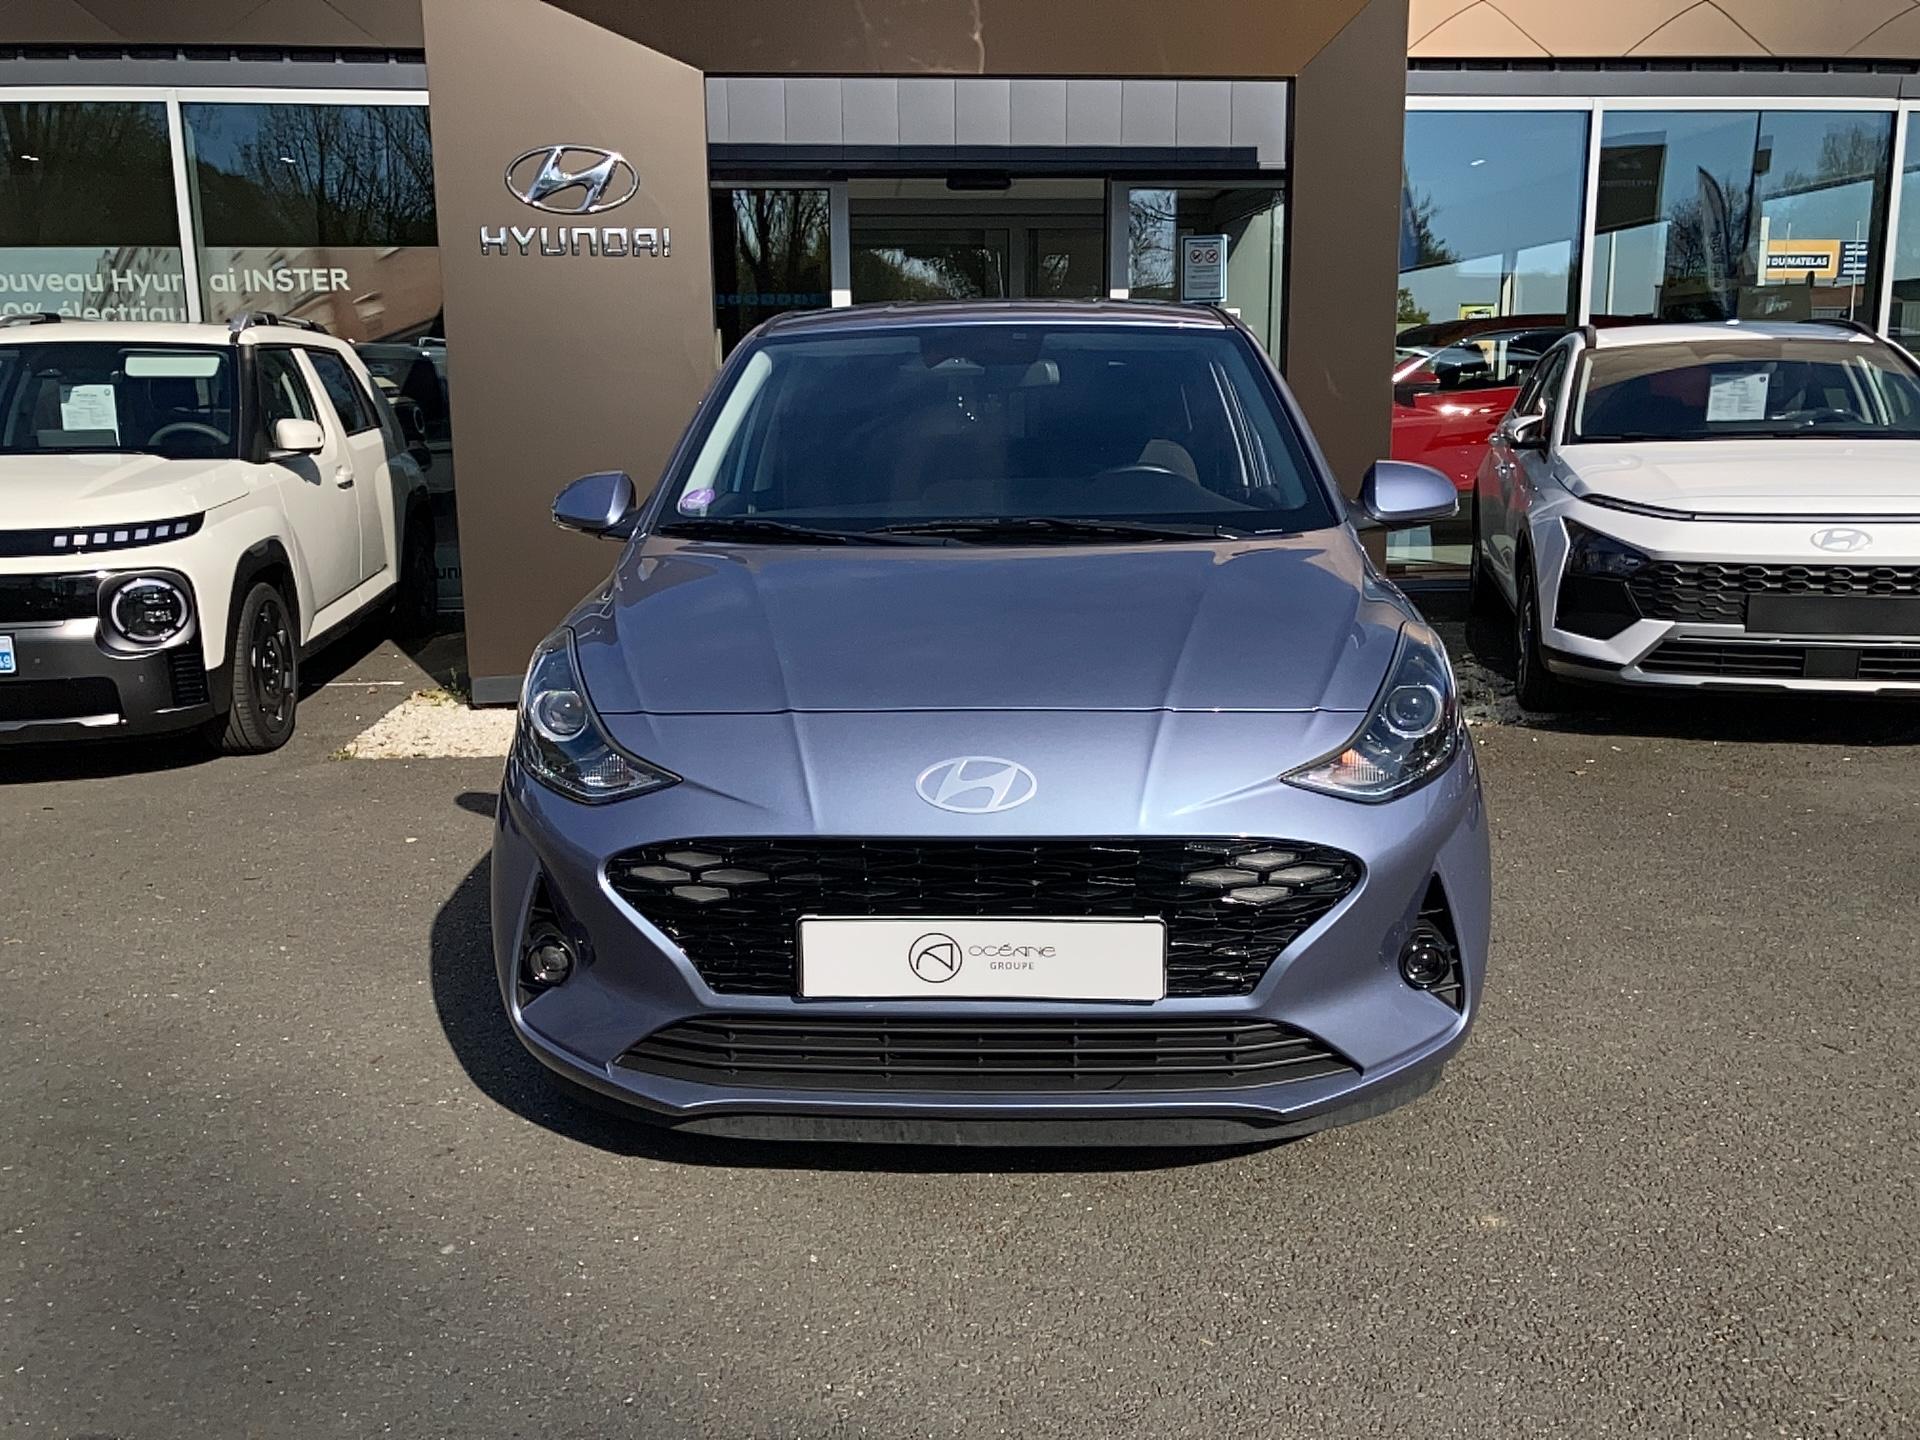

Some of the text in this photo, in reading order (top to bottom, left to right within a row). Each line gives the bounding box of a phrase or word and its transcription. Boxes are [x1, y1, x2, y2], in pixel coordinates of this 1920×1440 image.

[479, 225, 672, 257] HYUNDAI
[1786, 257, 1828, 266] MATELAS
[0, 268, 351, 297] ouveau Hyunai INSTER
[990, 961, 1035, 970] GROUPE
